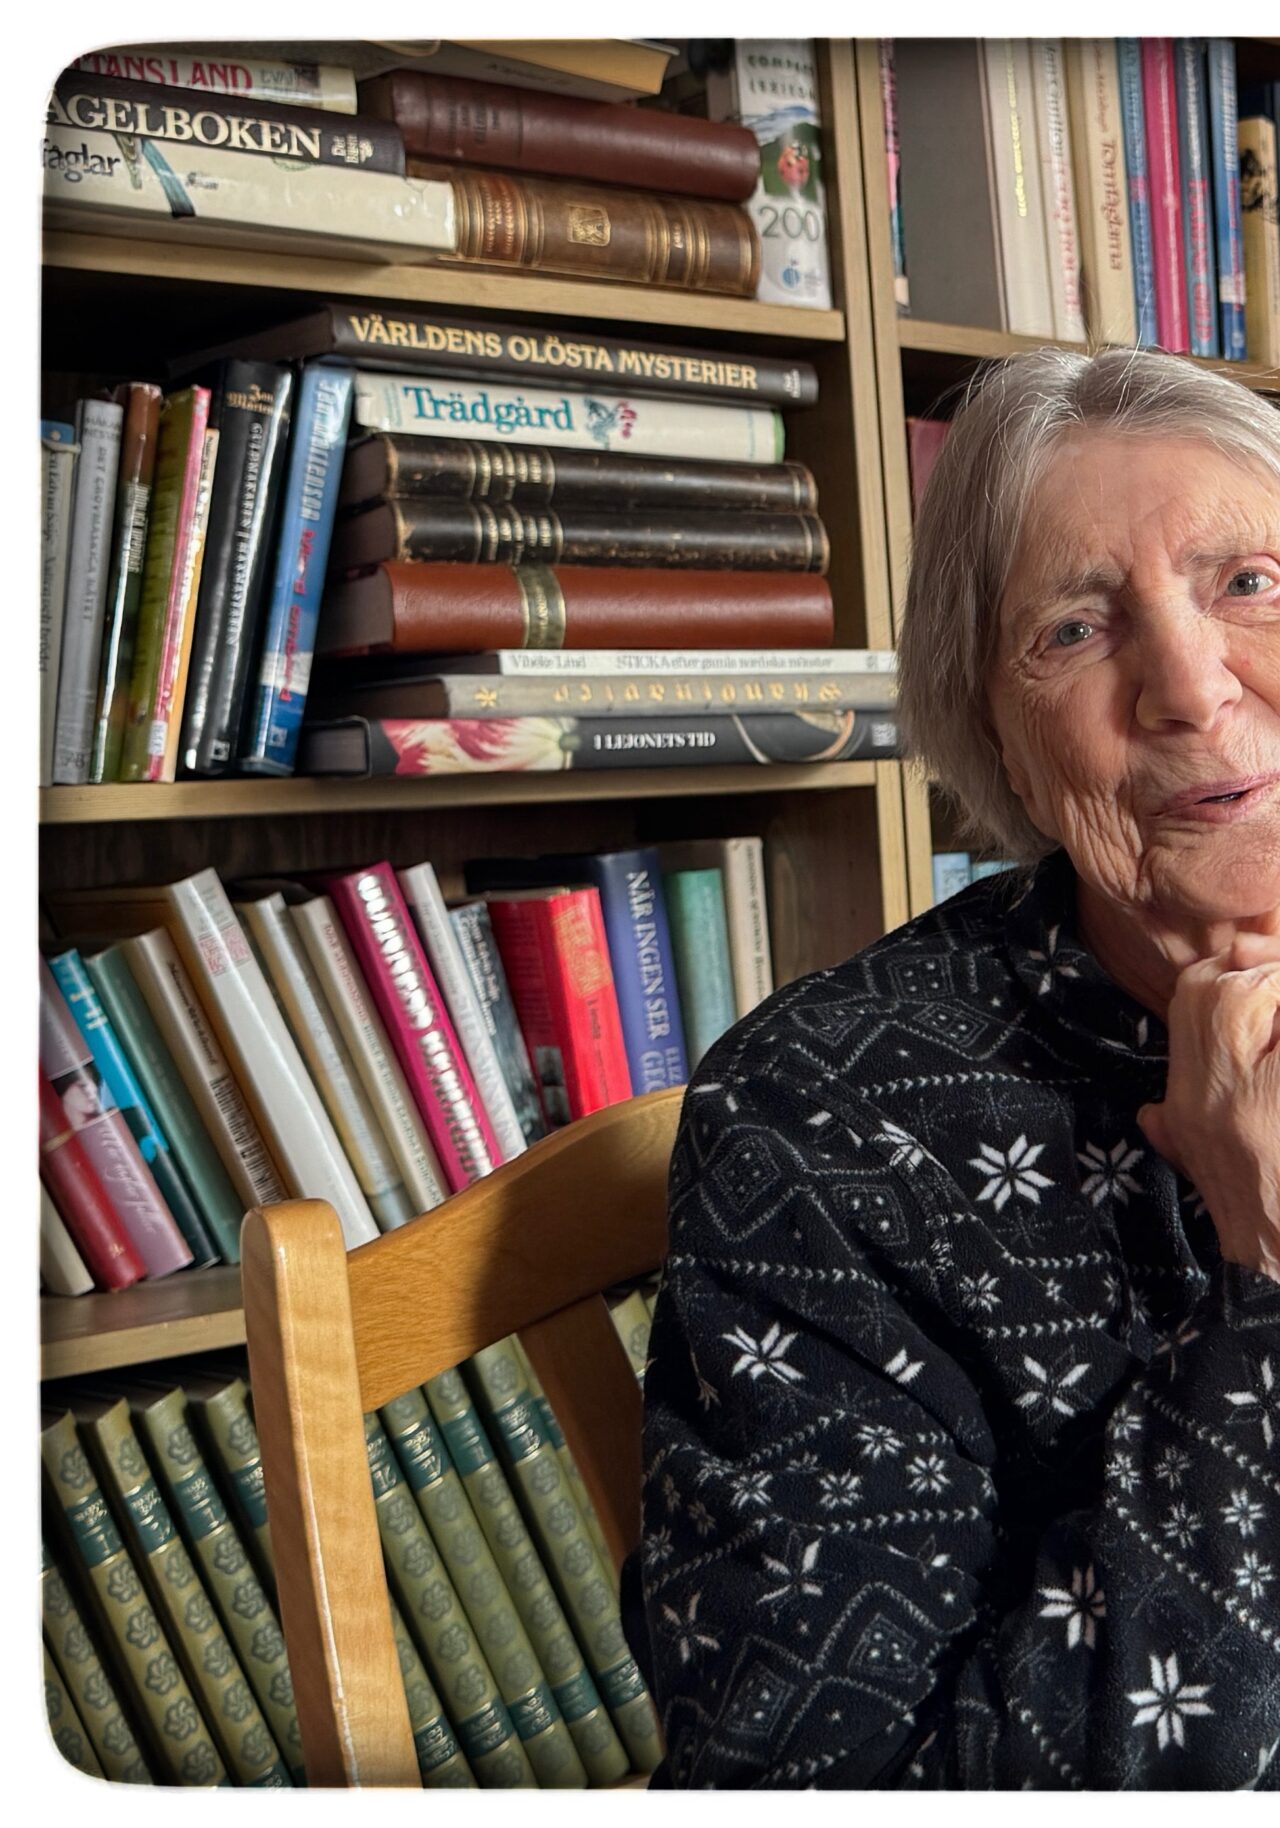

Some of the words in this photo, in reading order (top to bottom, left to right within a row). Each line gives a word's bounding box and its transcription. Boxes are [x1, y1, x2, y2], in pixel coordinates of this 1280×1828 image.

[348, 314, 502, 358] VÄRLDENS
[507, 333, 613, 372] OLÖSTA
[618, 352, 758, 391] MYSTERIER
[402, 384, 575, 434] Trädgård
[592, 734, 602, 750] I
[604, 732, 686, 750] LEJONETS
[687, 731, 717, 748] TID
[625, 869, 655, 920] NÄR
[631, 921, 667, 997] INGEN
[643, 997, 672, 1040] SER
